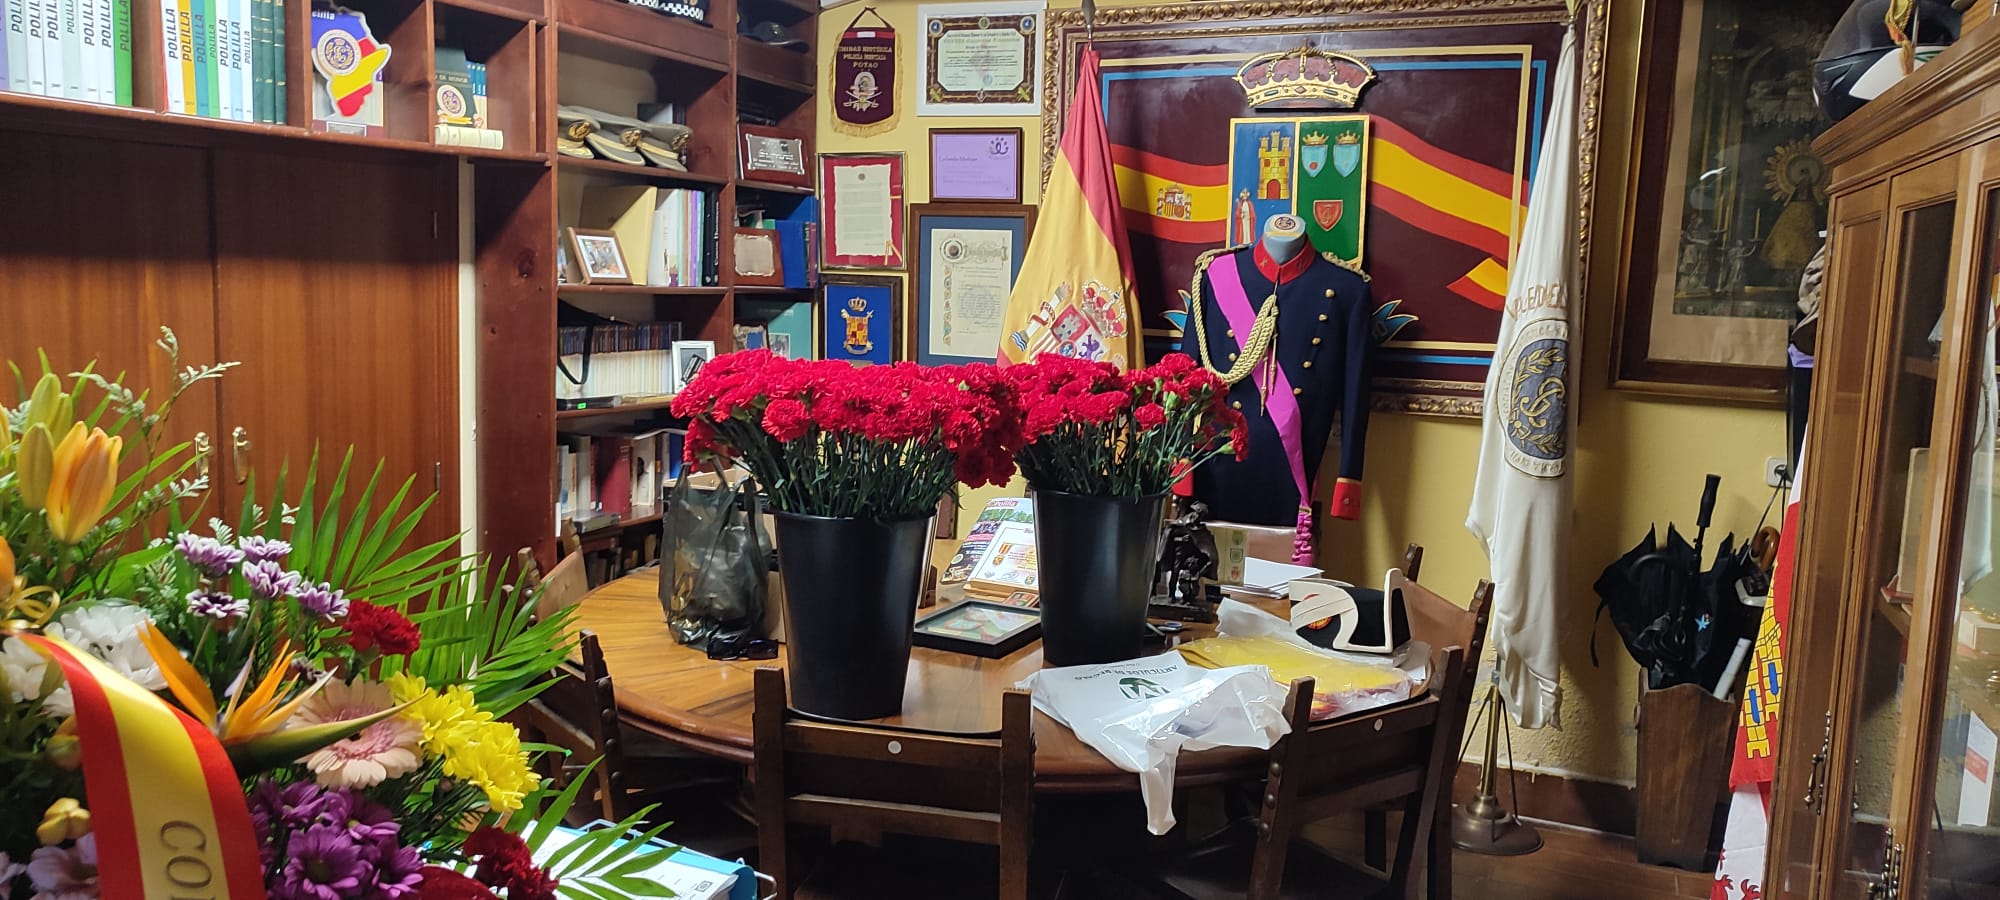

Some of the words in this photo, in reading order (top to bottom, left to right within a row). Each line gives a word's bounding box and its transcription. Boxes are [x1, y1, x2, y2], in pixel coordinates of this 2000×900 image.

[165, 8, 179, 59] POLILLA
[179, 11, 193, 62] POLILLA
[194, 14, 207, 64] POLILLA
[208, 24, 217, 59] POLILLA
[218, 19, 229, 68] POLILLA
[231, 21, 242, 70] POLILLA
[243, 30, 251, 64] POLILLA
[160, 820, 215, 900] CO
